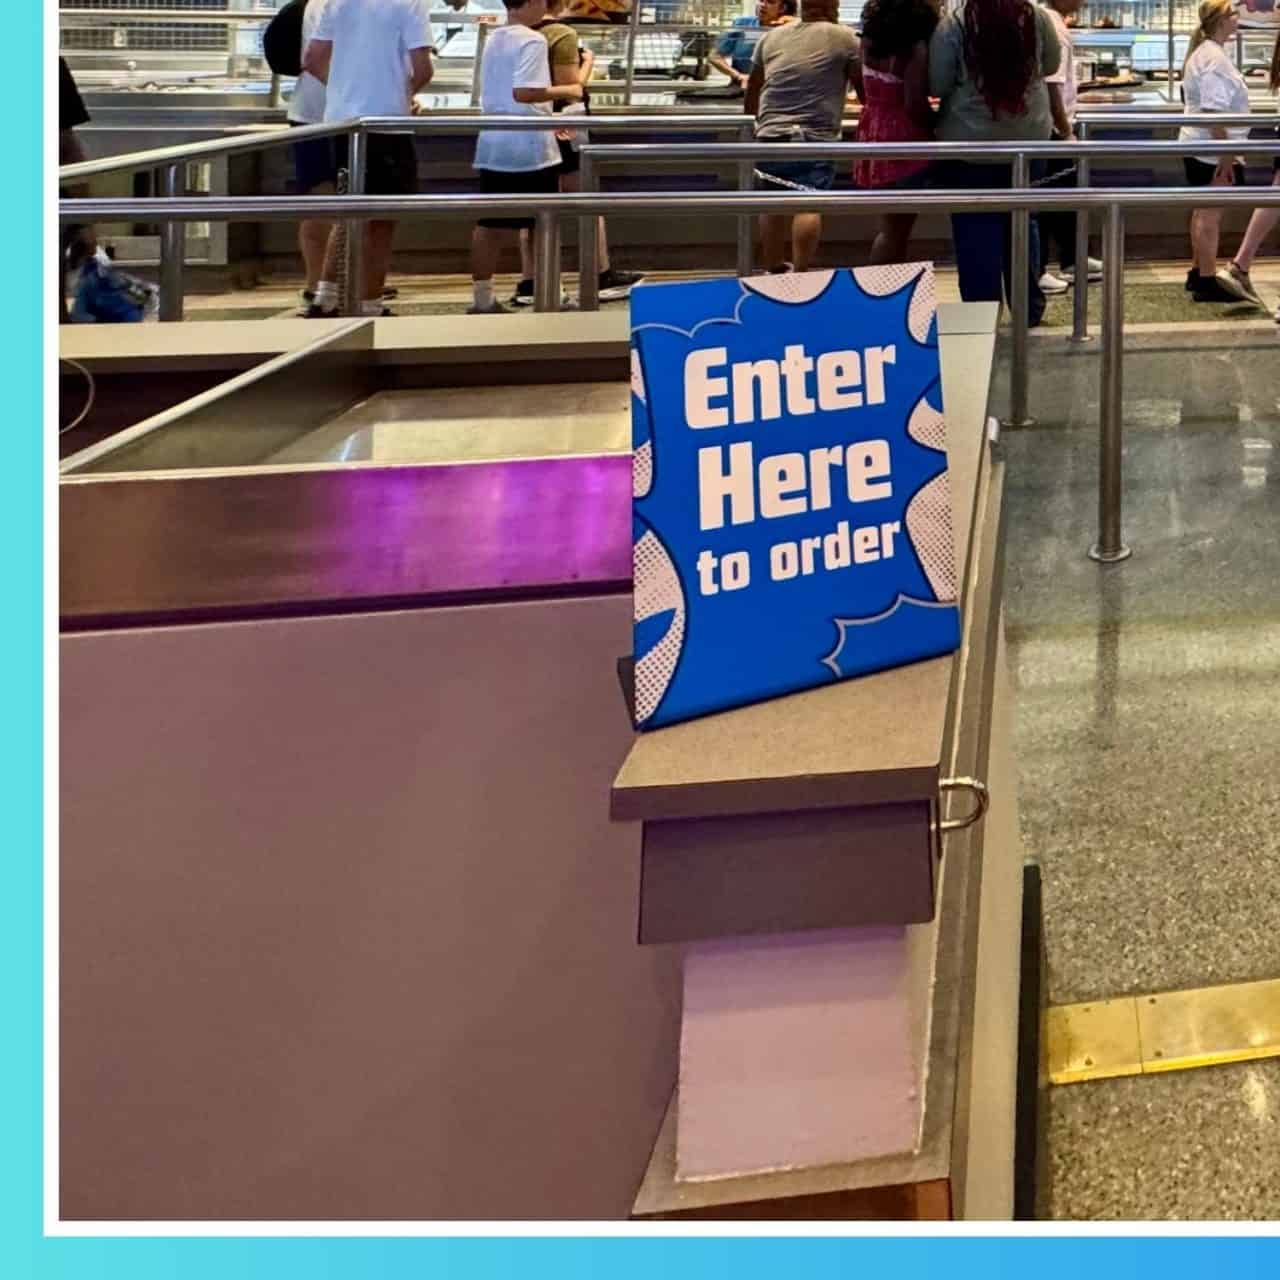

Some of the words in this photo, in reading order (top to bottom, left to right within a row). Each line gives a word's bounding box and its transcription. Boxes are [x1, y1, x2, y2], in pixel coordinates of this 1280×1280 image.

[684, 343, 897, 430] Enter
[696, 438, 893, 531] Here
[696, 548, 751, 596] to
[769, 518, 901, 582] order
